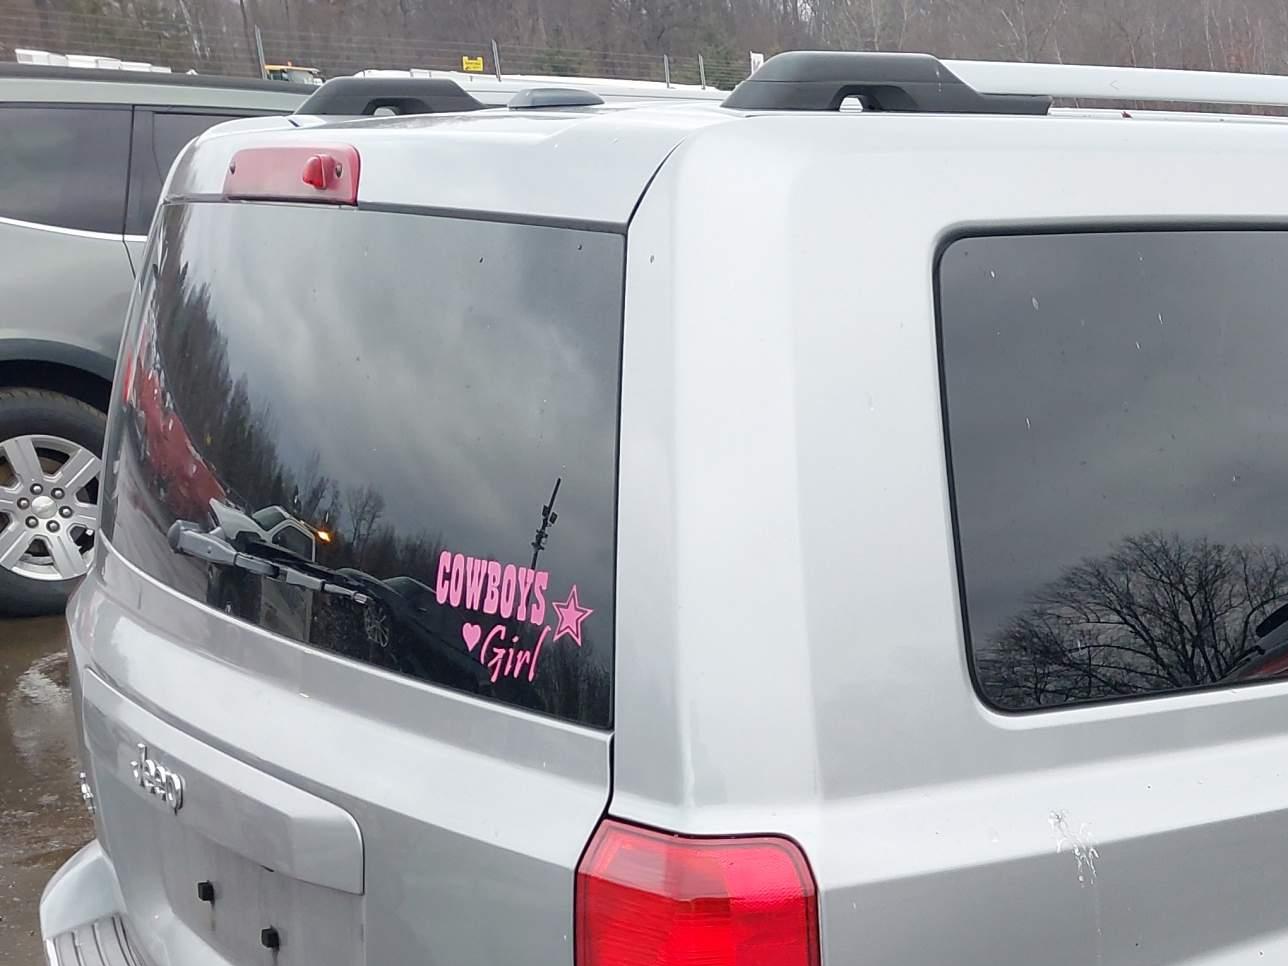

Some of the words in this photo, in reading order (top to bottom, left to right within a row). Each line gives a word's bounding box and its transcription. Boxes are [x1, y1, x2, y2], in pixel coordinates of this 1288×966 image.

[435, 550, 549, 626] COWBOYS
[480, 624, 551, 683] Girl
[130, 743, 184, 816] Jeep
